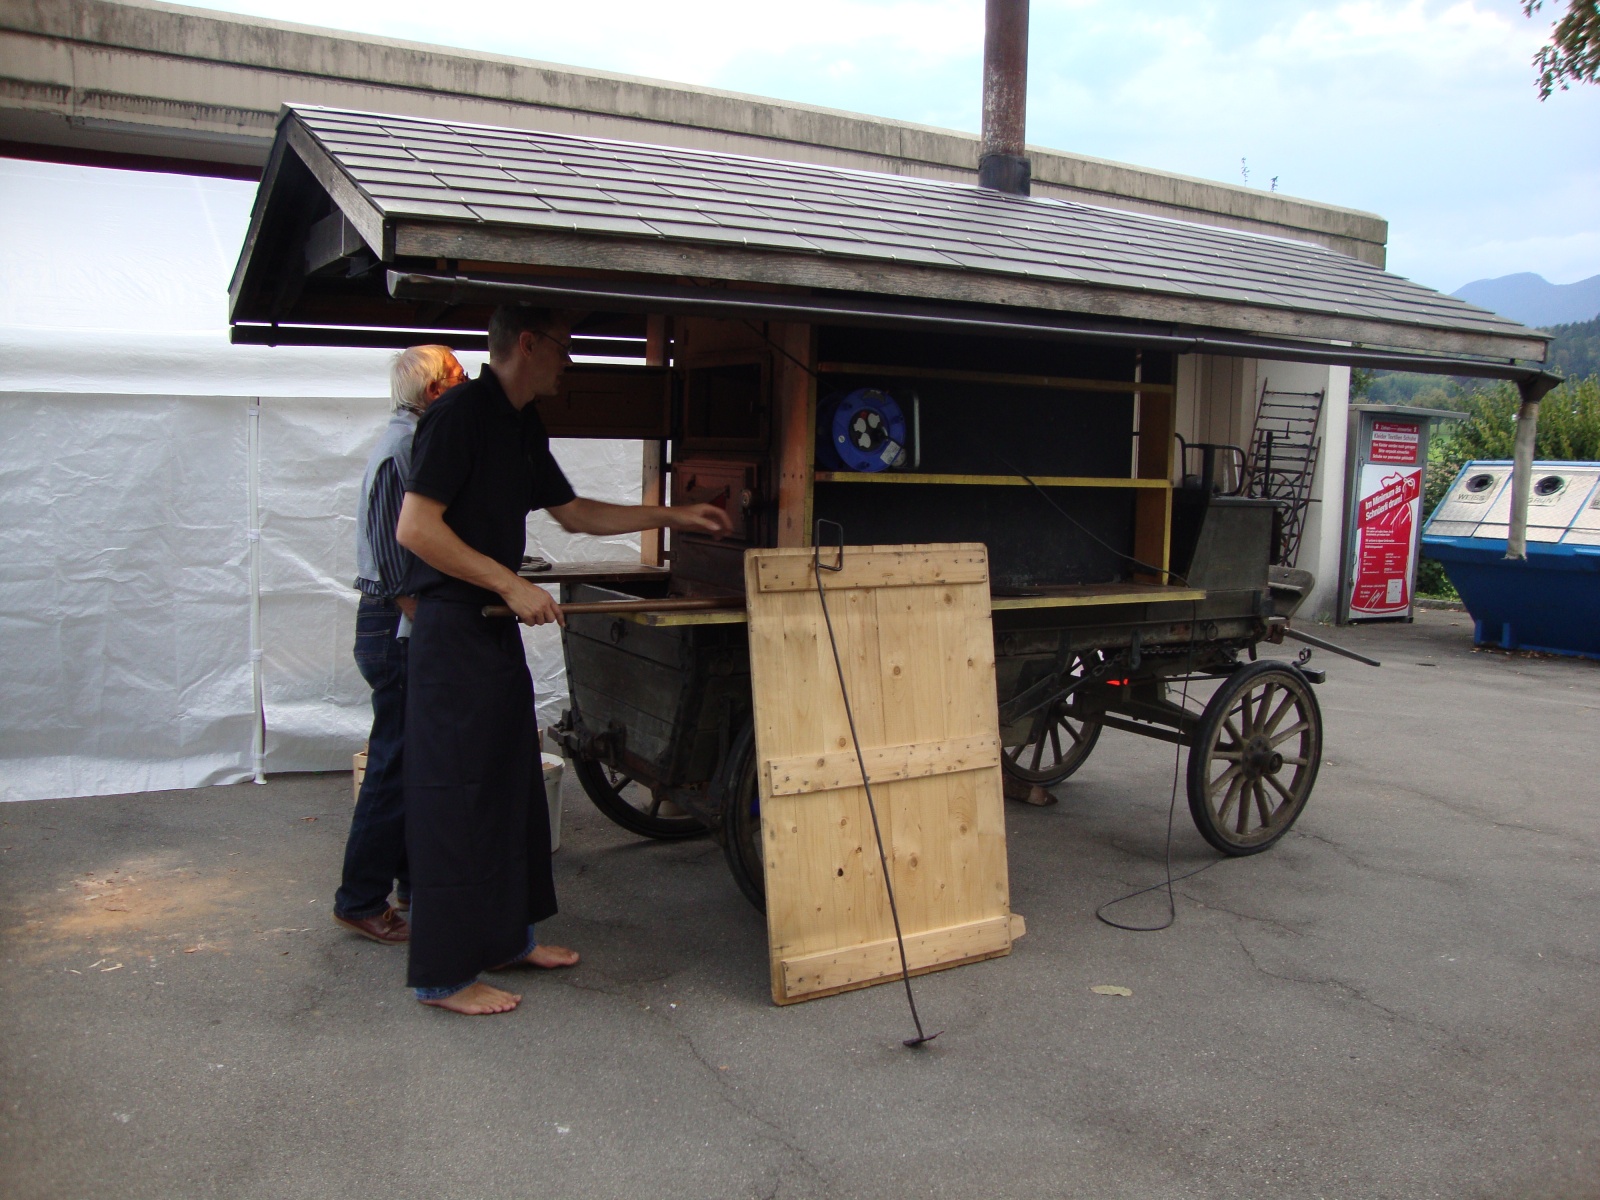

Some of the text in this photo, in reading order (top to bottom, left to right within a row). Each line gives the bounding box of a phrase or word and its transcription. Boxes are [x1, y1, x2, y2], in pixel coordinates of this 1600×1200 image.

[1365, 501, 1373, 510] Im
[1372, 488, 1395, 507] Minimum
[1458, 493, 1486, 501] WEISS
